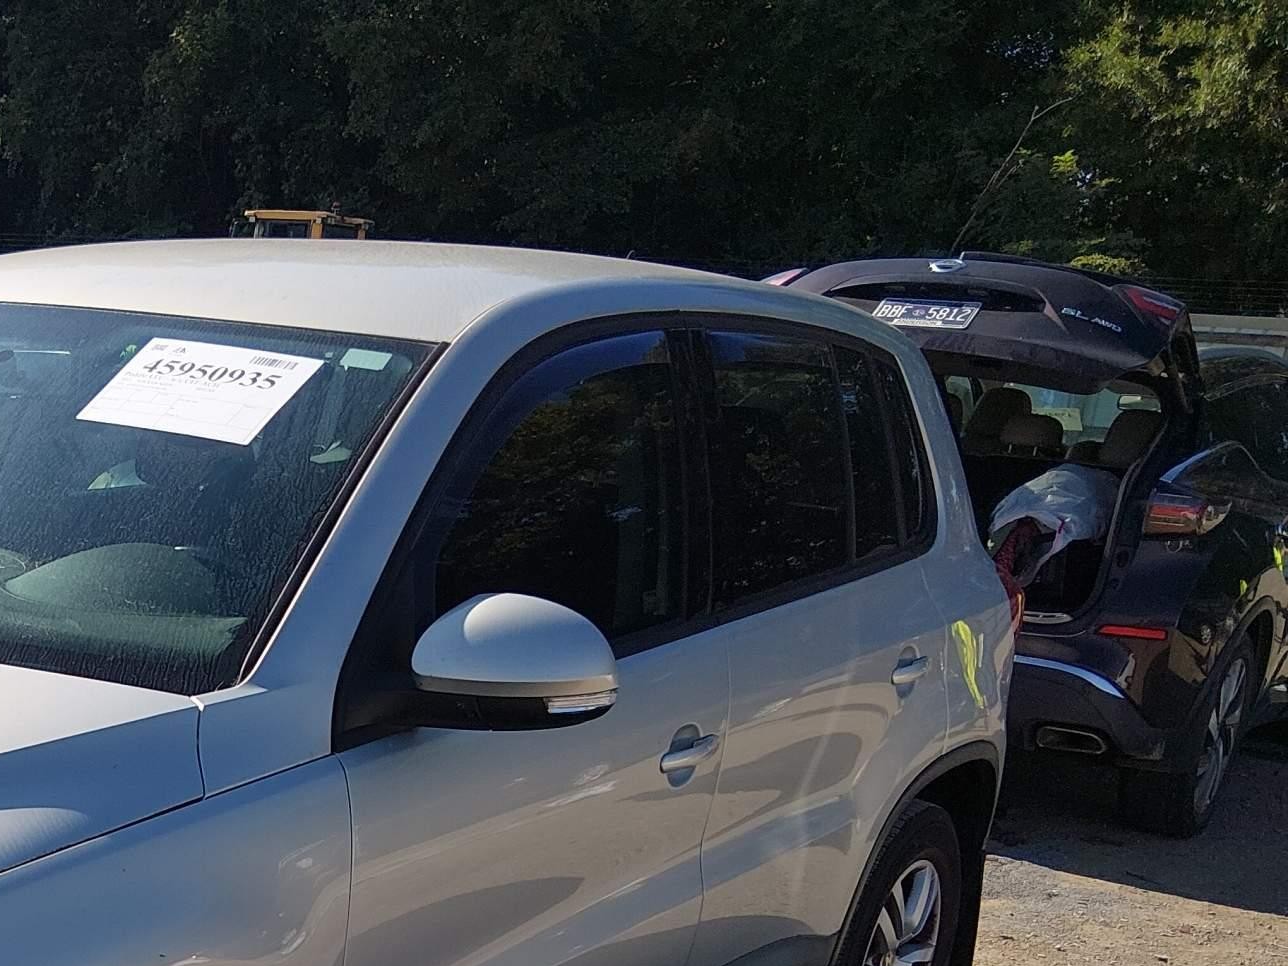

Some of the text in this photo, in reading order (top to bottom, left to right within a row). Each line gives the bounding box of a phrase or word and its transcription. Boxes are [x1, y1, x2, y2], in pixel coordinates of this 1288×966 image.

[876, 304, 972, 322] BBF 5812
[1091, 317, 1122, 333] AWD
[143, 358, 283, 390] 45950935
